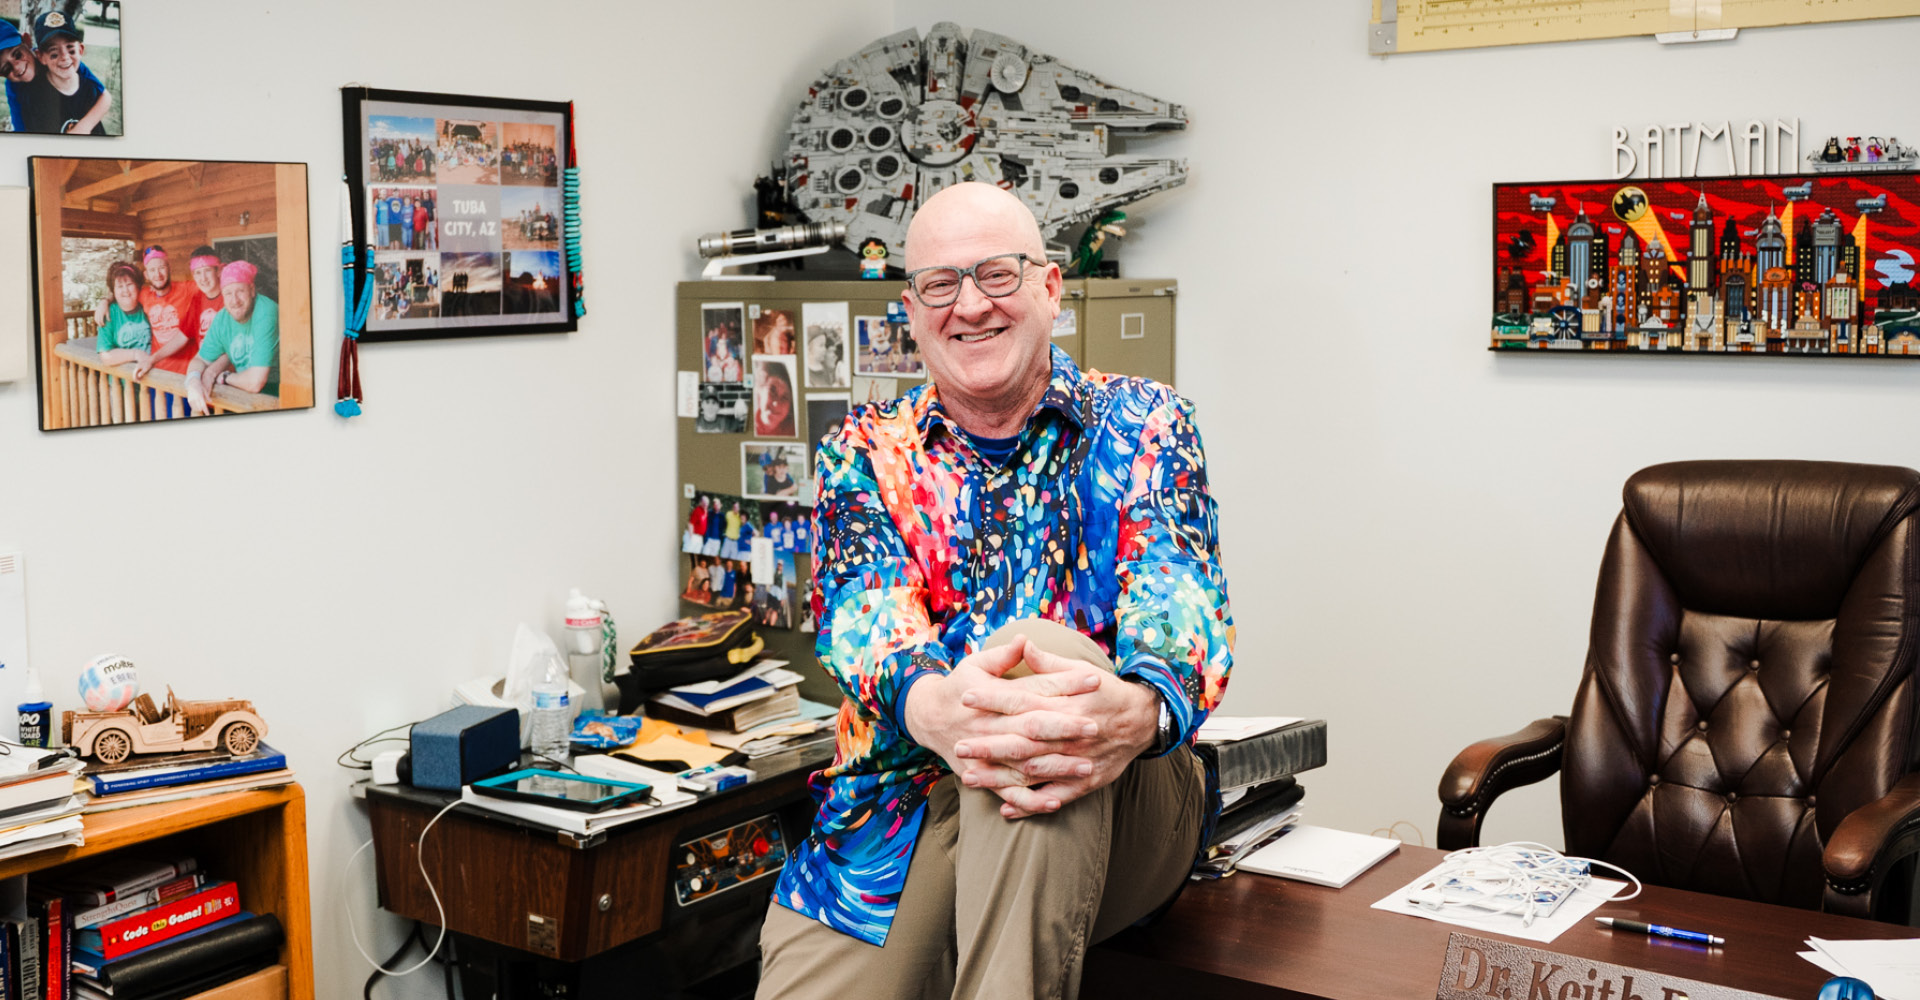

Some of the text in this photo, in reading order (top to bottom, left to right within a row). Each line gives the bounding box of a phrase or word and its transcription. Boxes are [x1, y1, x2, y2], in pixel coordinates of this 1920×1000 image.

[1612, 117, 1800, 180] BATMAN
[452, 200, 487, 215] TUBA
[444, 221, 497, 237] CITY, AZ
[81, 898, 137, 923] StrengthsQuest
[122, 926, 149, 941] Code
[152, 919, 166, 931] this
[168, 906, 202, 926] Game!
[1453, 945, 1512, 1000] Dr.
